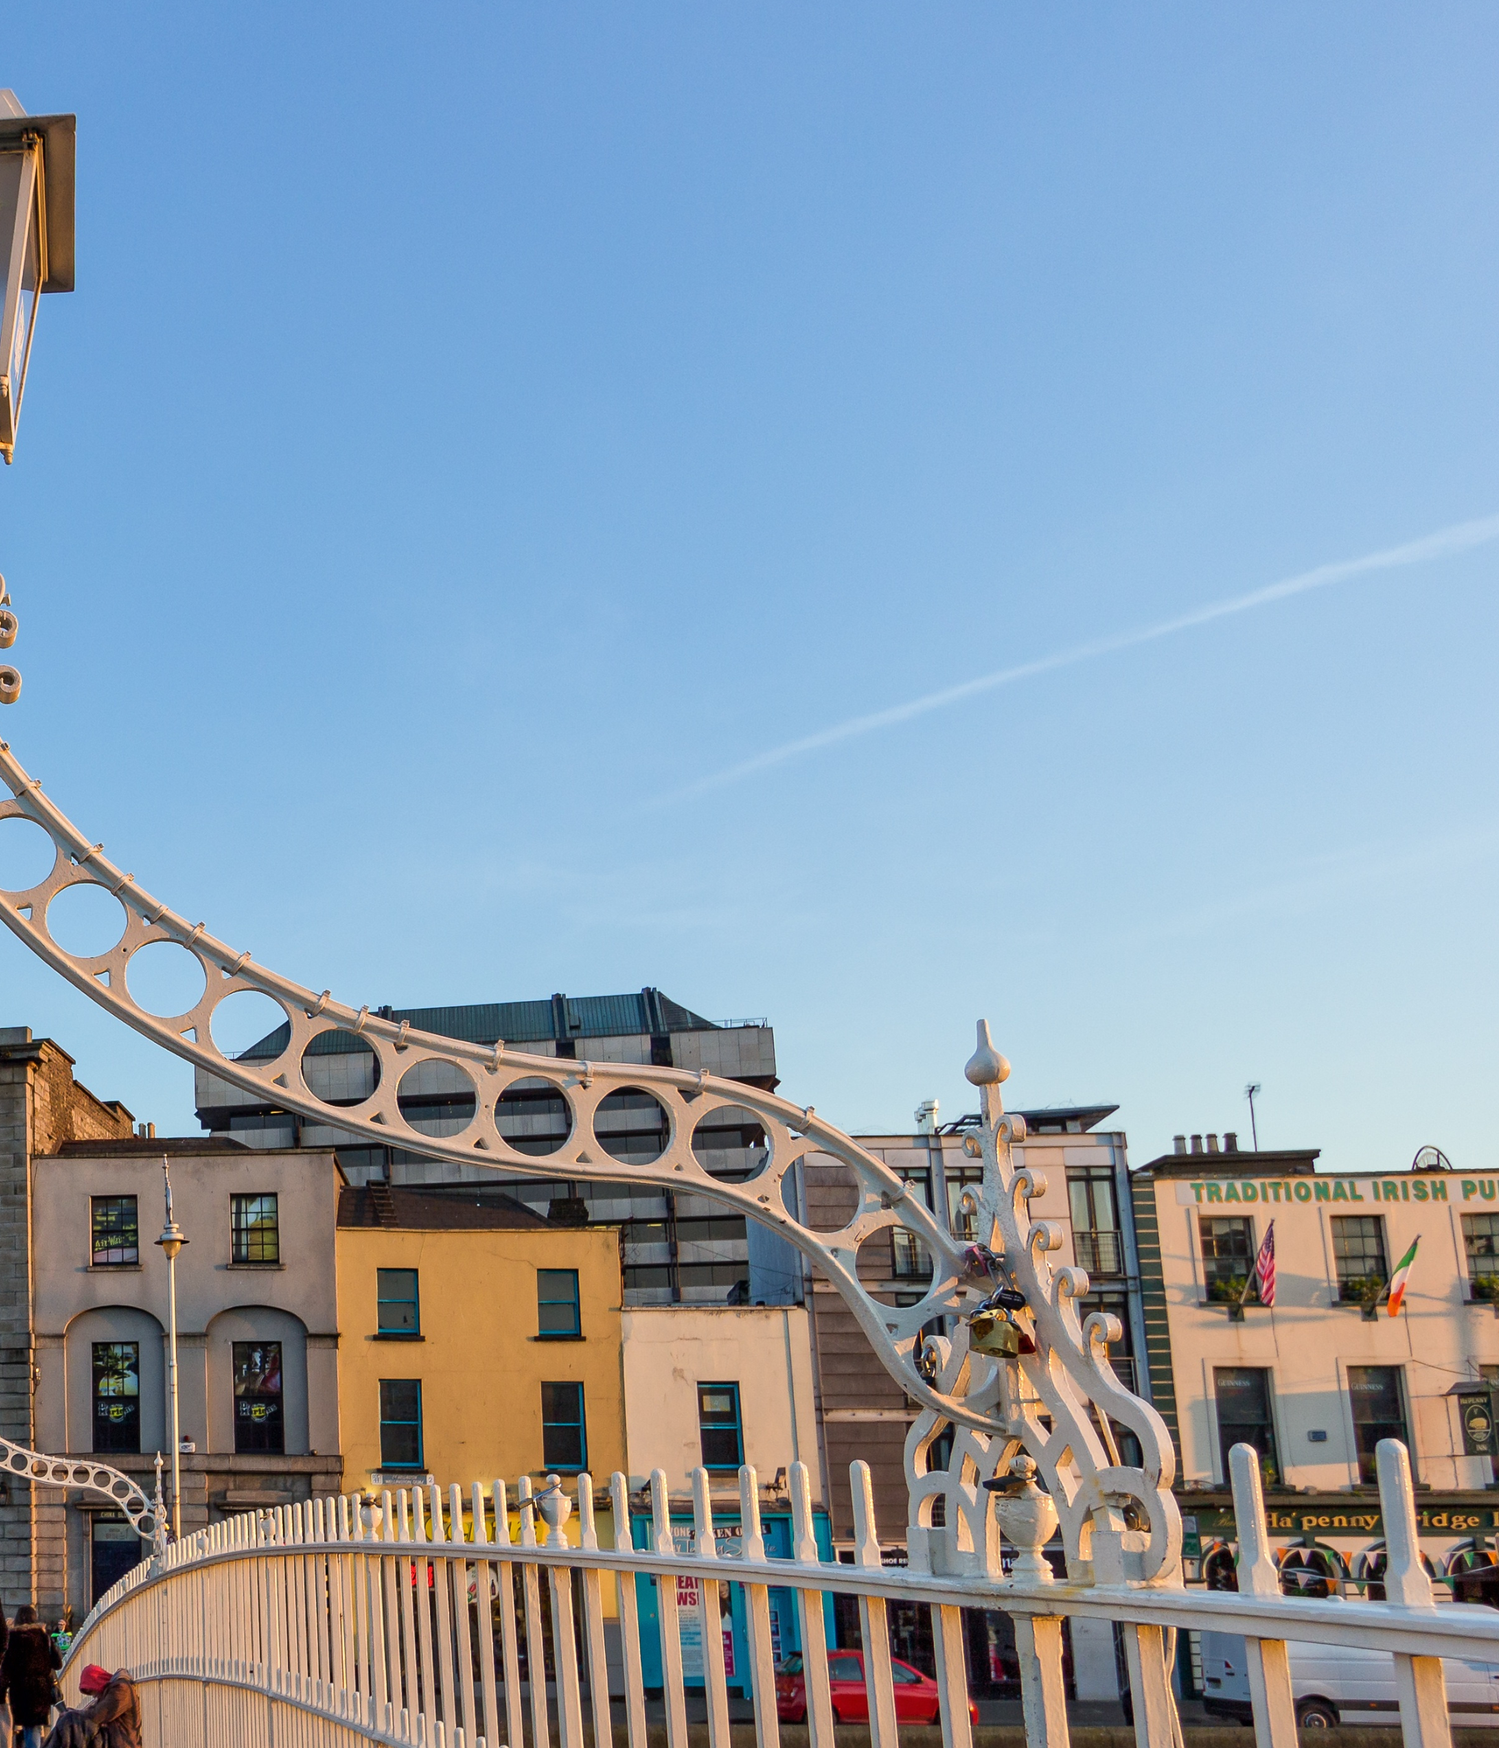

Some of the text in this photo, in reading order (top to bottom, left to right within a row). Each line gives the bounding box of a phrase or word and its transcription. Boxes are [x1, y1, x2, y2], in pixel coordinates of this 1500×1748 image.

[1190, 1179, 1499, 1204] TRADITIONAL IRISH PU
[1217, 1378, 1250, 1388] GUINNESS
[1351, 1382, 1384, 1391] GUINNESS
